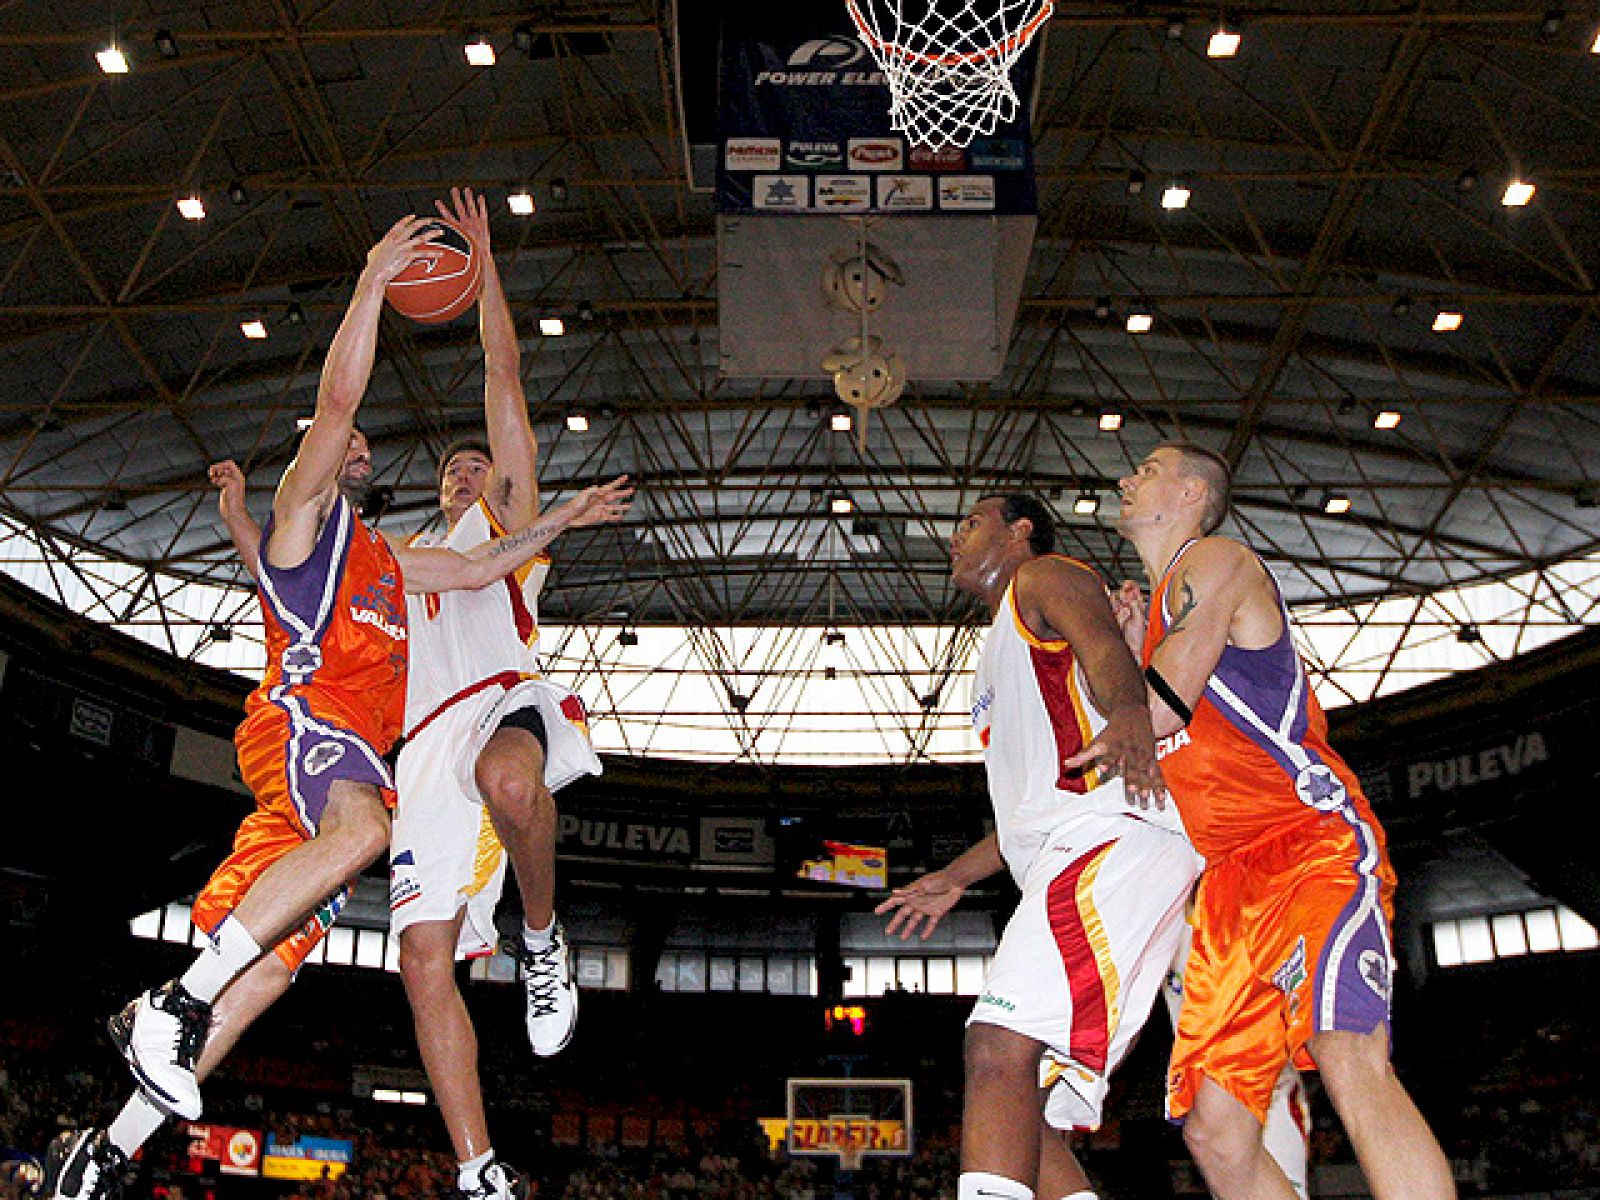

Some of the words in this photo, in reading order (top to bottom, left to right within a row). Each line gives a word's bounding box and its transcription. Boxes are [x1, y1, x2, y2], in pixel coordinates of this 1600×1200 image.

[755, 71, 836, 86] POWER
[1407, 731, 1549, 799] PULEVA
[556, 812, 690, 854] PULEVA
